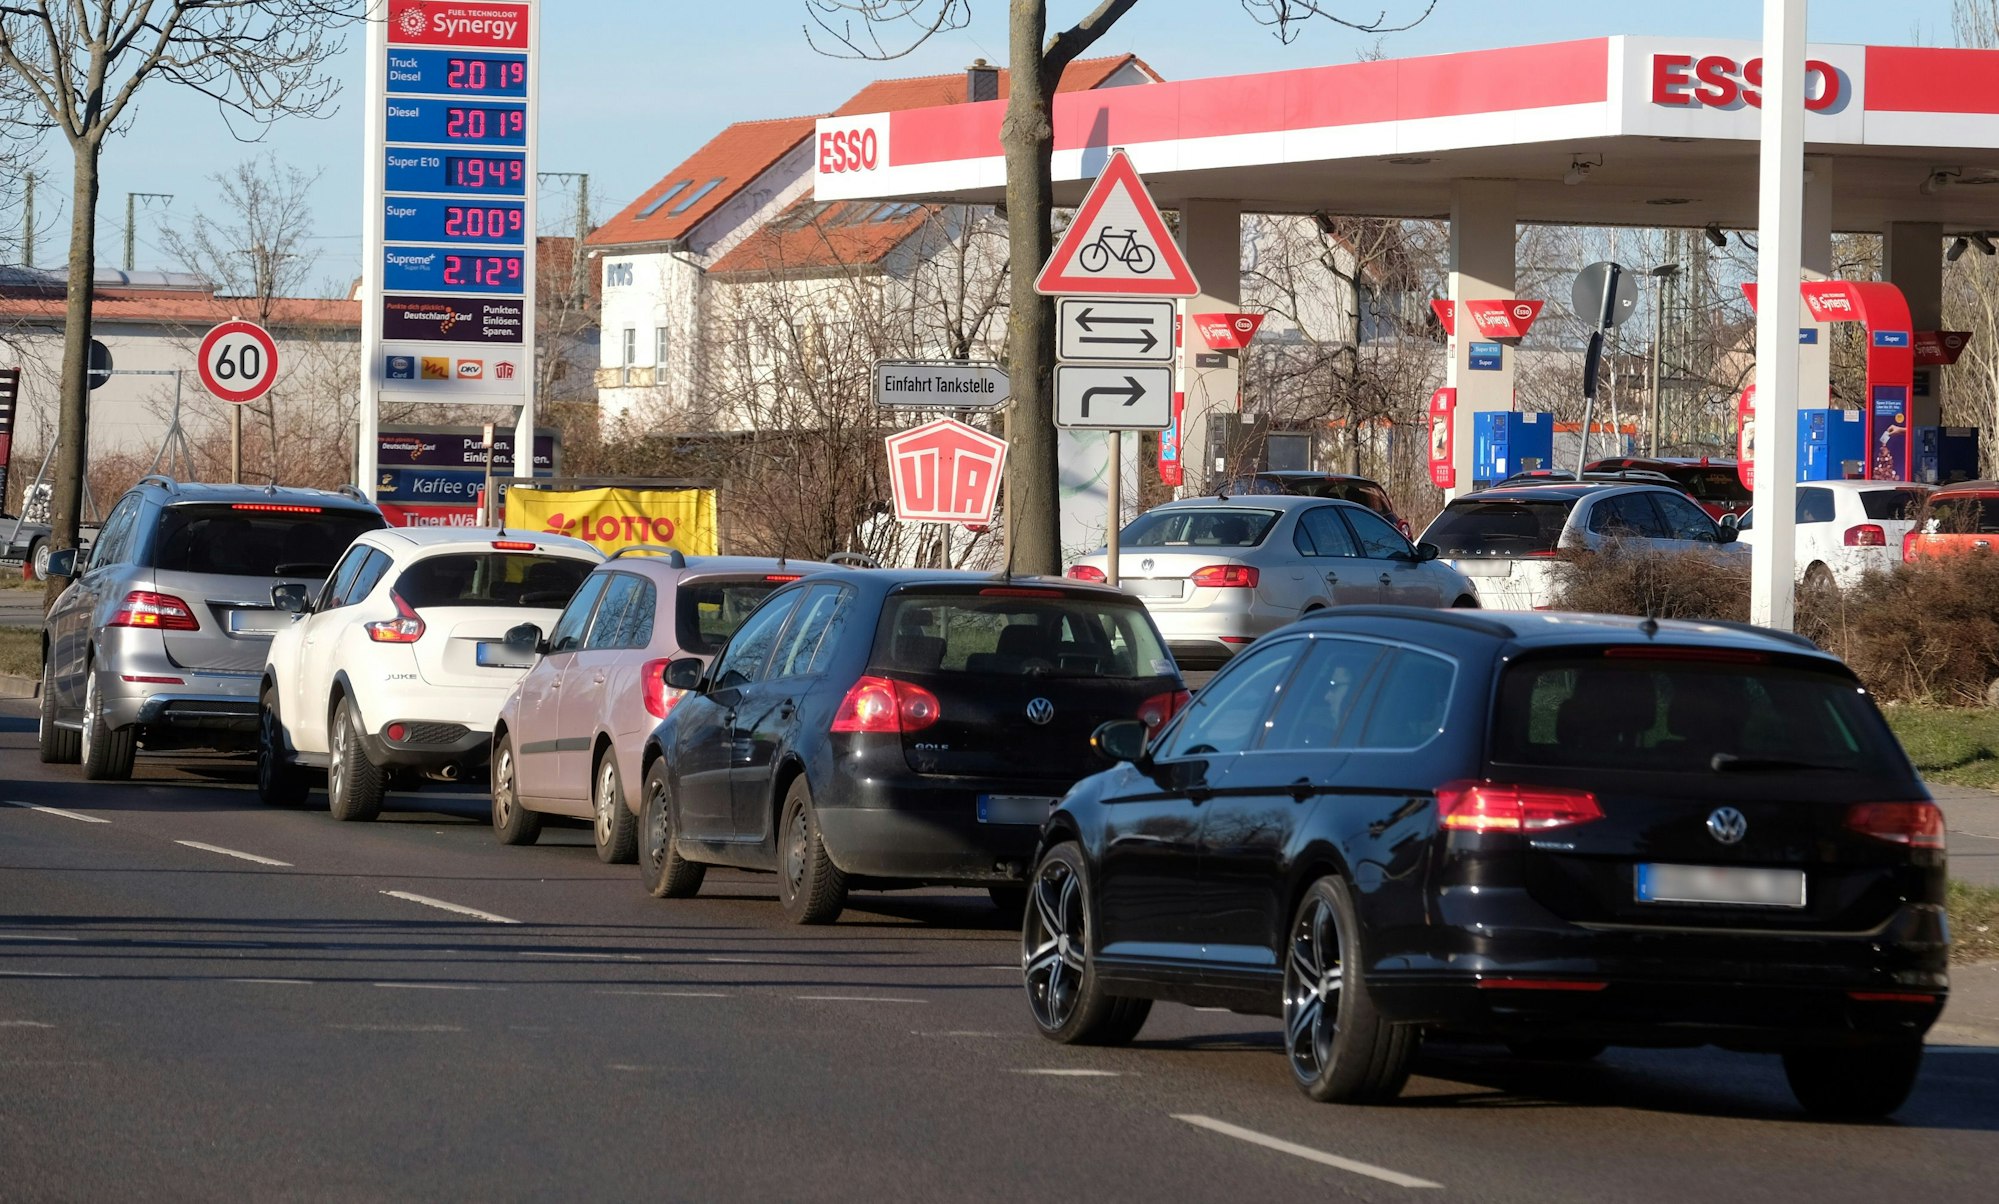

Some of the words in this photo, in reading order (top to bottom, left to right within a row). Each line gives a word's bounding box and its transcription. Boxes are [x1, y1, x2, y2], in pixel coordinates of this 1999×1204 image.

[468, 10, 517, 18] TECHNOLOGY
[433, 13, 517, 40] Synergy
[390, 57, 418, 68] Truck
[390, 71, 421, 81] Diesel
[388, 107, 419, 117] Diesel
[819, 128, 877, 173] ESSO
[387, 156, 418, 169] Super
[420, 157, 440, 167] E10
[457, 159, 522, 187] 1.949
[386, 205, 417, 218] Super
[445, 207, 521, 237] 2.009
[443, 256, 520, 286] 2.129
[483, 305, 521, 315] Punkten.
[1819, 296, 1852, 312] Synergy
[404, 311, 450, 321] Deutschland
[455, 313, 472, 322] Card
[1447, 308, 1453, 318] 3
[483, 316, 521, 326] Einlösen.
[1483, 314, 1511, 328] Synergy
[483, 326, 515, 337] Sparen.
[215, 344, 260, 380] 60
[495, 361, 514, 379] UTA
[885, 375, 932, 392] Einfahrt
[935, 376, 995, 393] Tankstelle
[898, 428, 997, 514] UTA
[412, 478, 462, 494] Kaffee
[582, 515, 675, 543] LOTTO
[385, 673, 417, 681] JUKE
